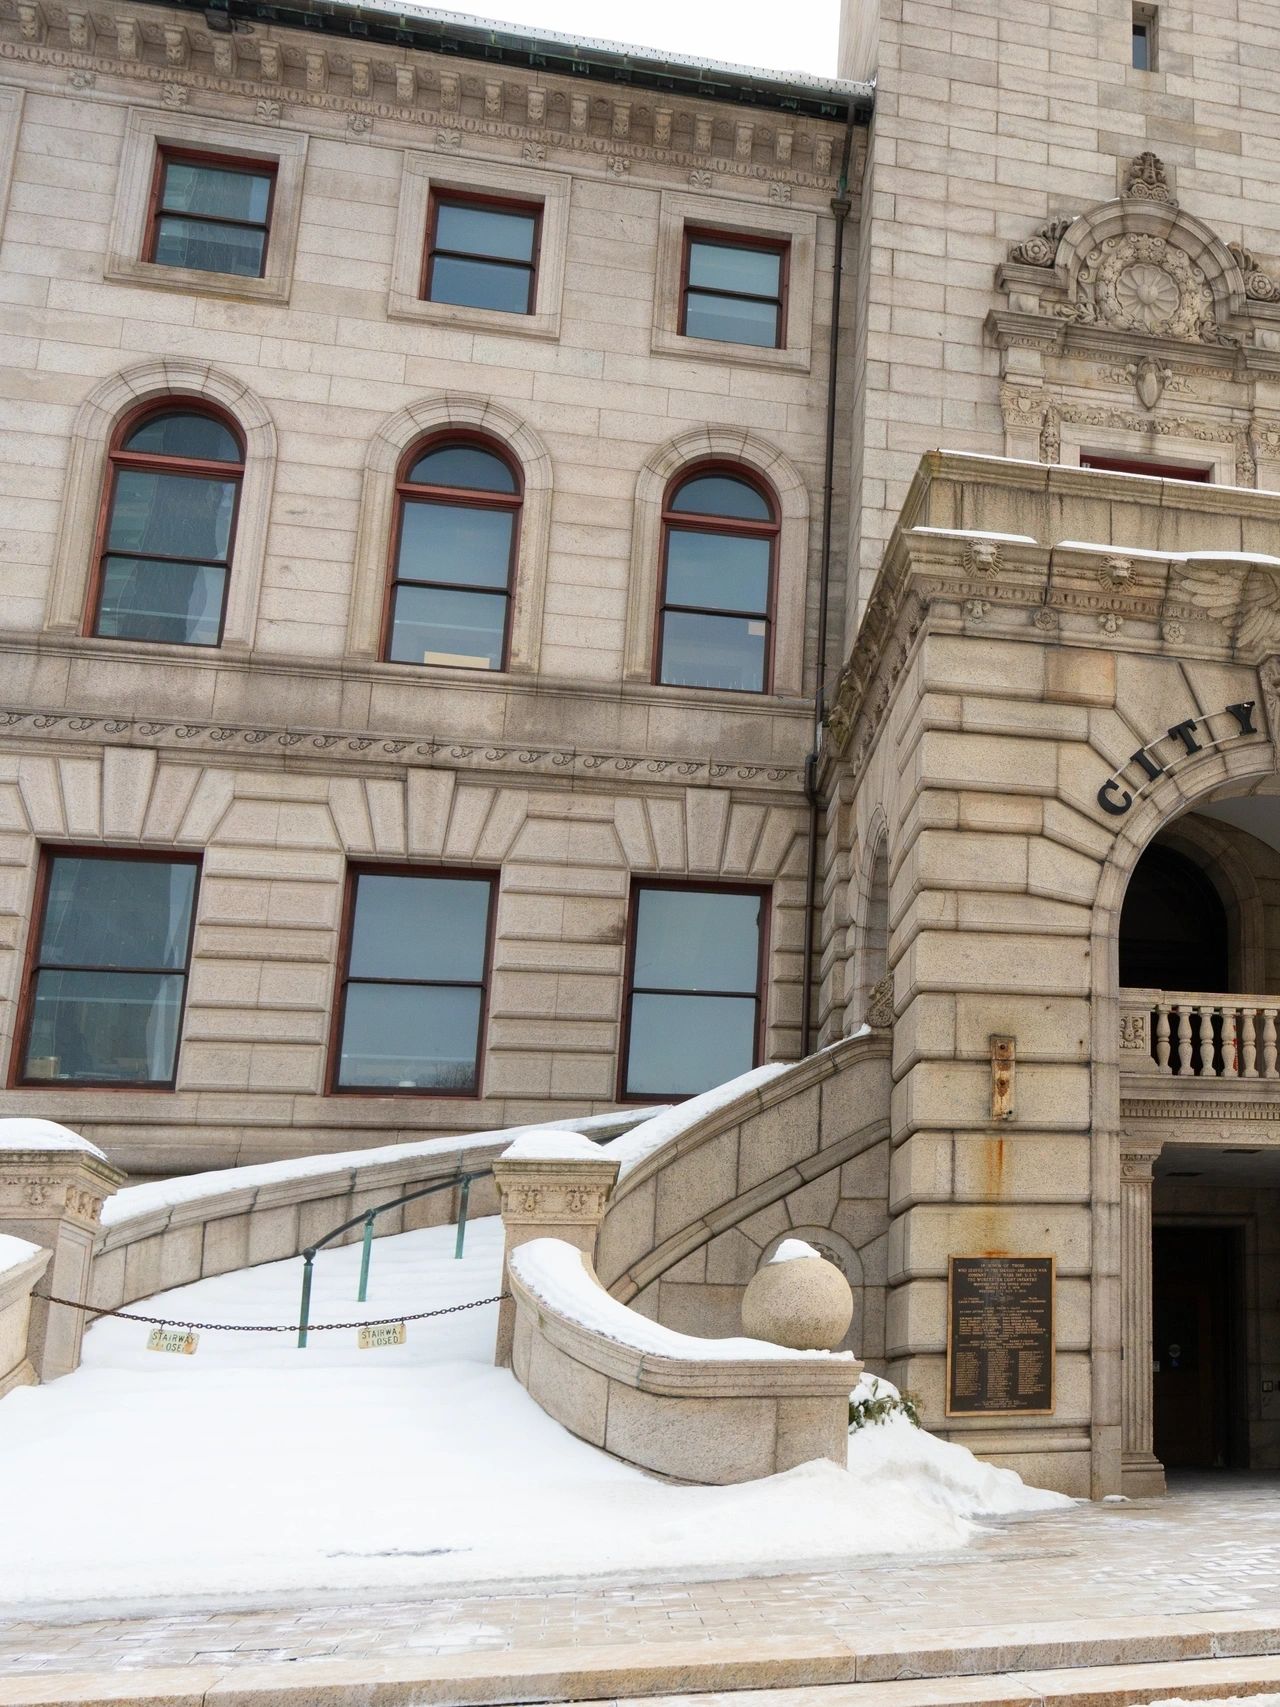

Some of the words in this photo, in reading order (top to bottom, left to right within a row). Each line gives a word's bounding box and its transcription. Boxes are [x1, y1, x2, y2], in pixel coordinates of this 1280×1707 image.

[1097, 701, 1257, 816] CITY
[361, 1328, 402, 1340] STAIRWA
[365, 1336, 399, 1347] LOSED
